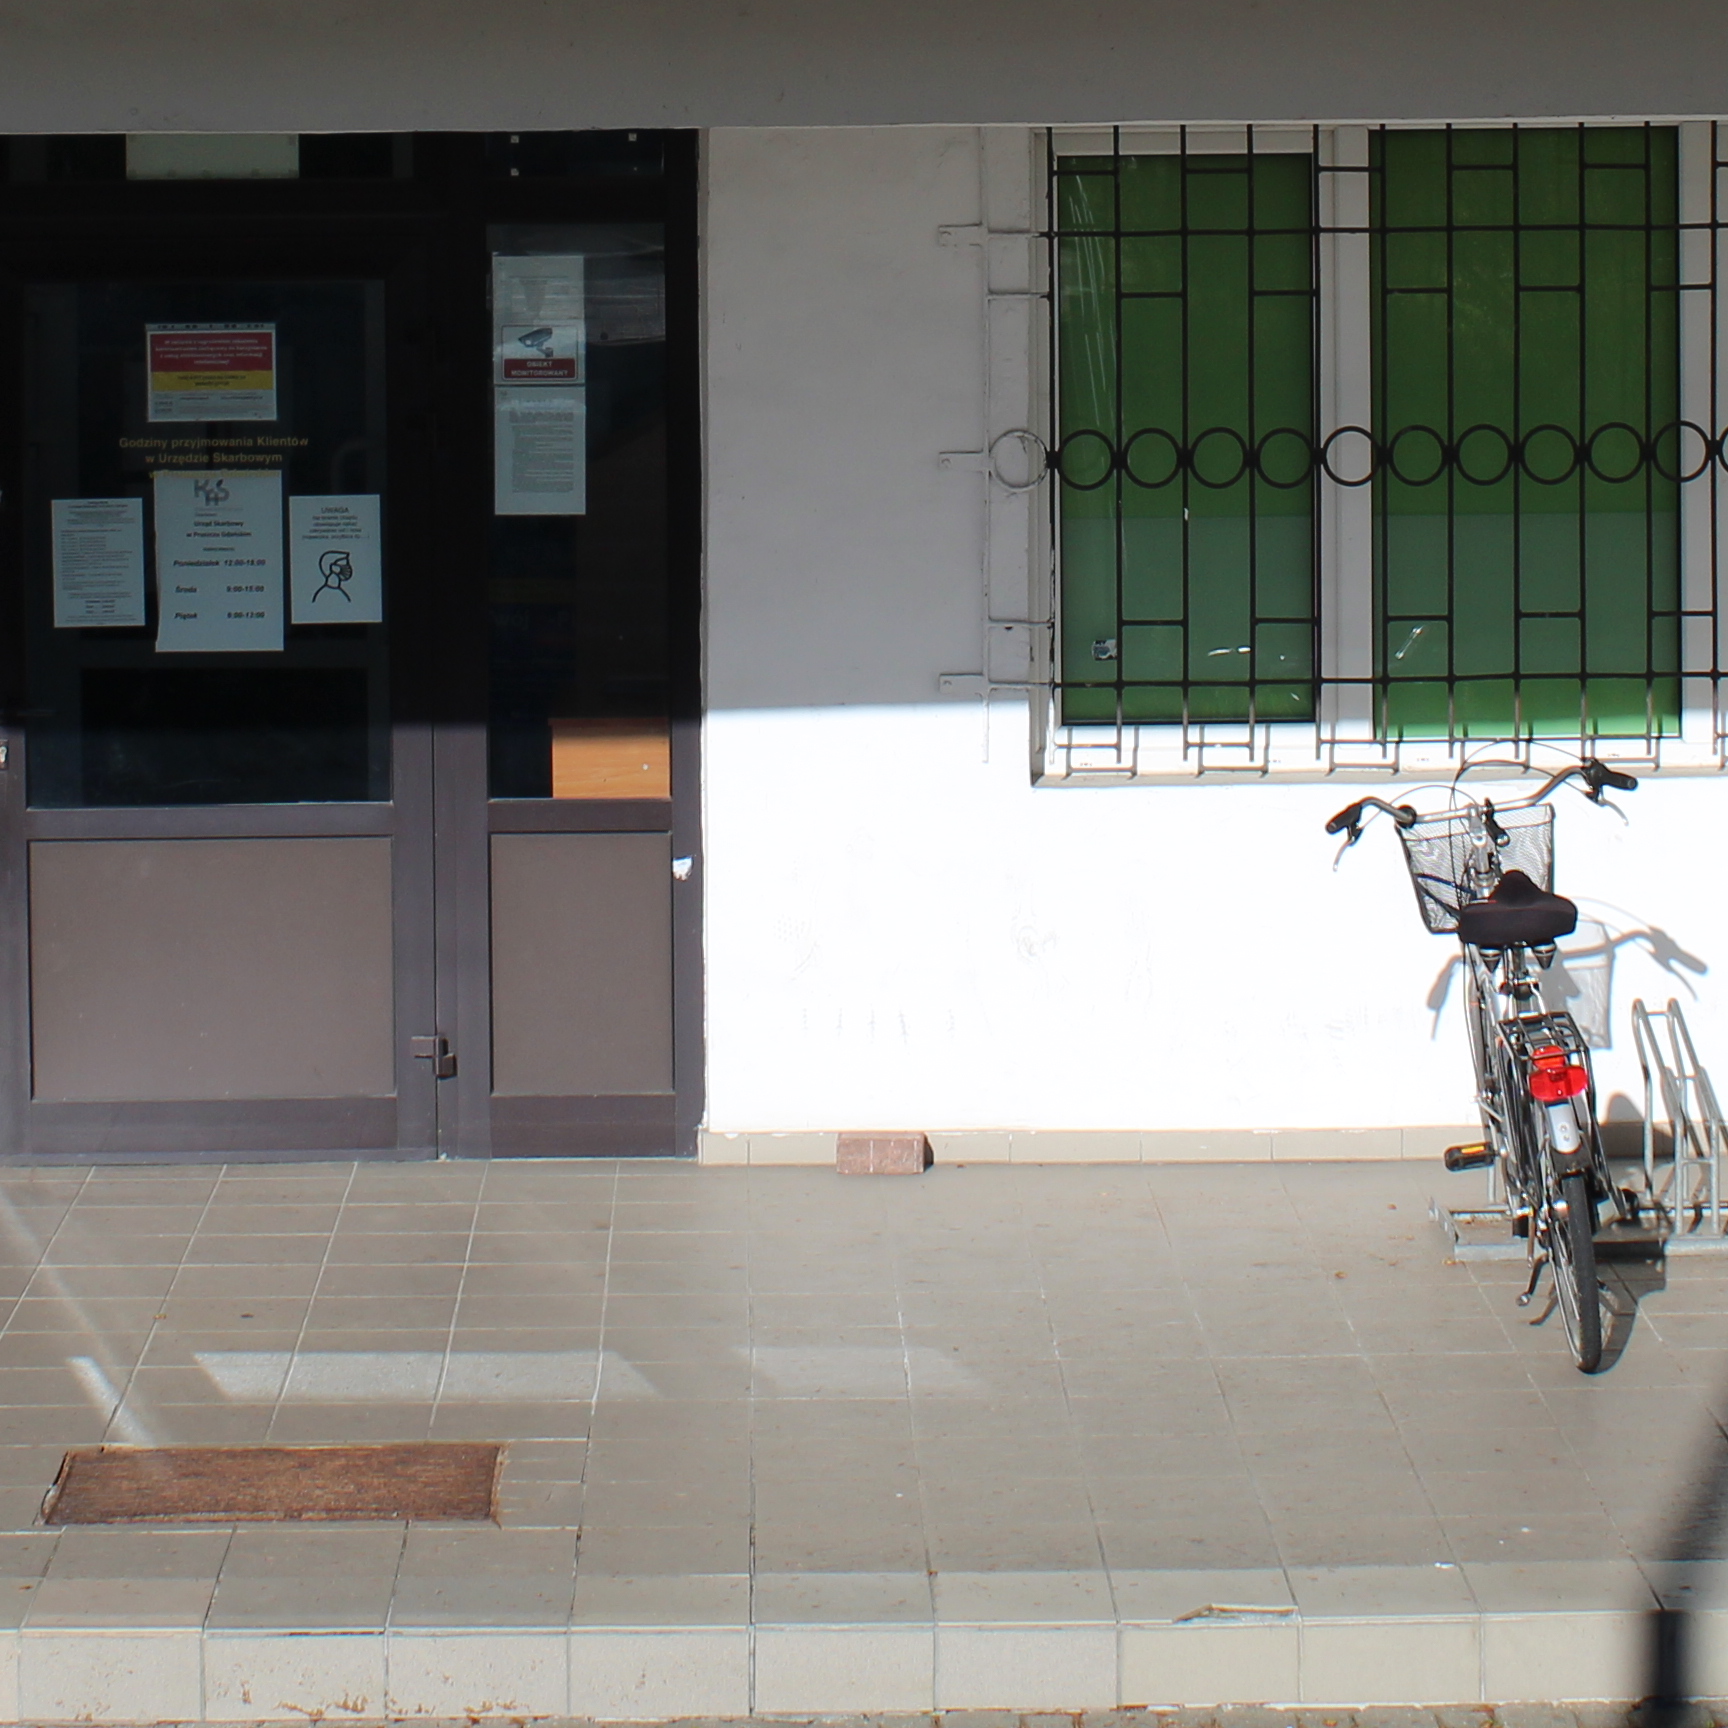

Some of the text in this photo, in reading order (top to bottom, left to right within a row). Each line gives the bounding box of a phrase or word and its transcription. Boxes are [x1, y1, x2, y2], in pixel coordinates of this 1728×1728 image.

[119, 435, 309, 449] Godziny przyjmowania Klientów
[158, 452, 210, 466] Urzędzie
[212, 452, 283, 465] Skarbowym
